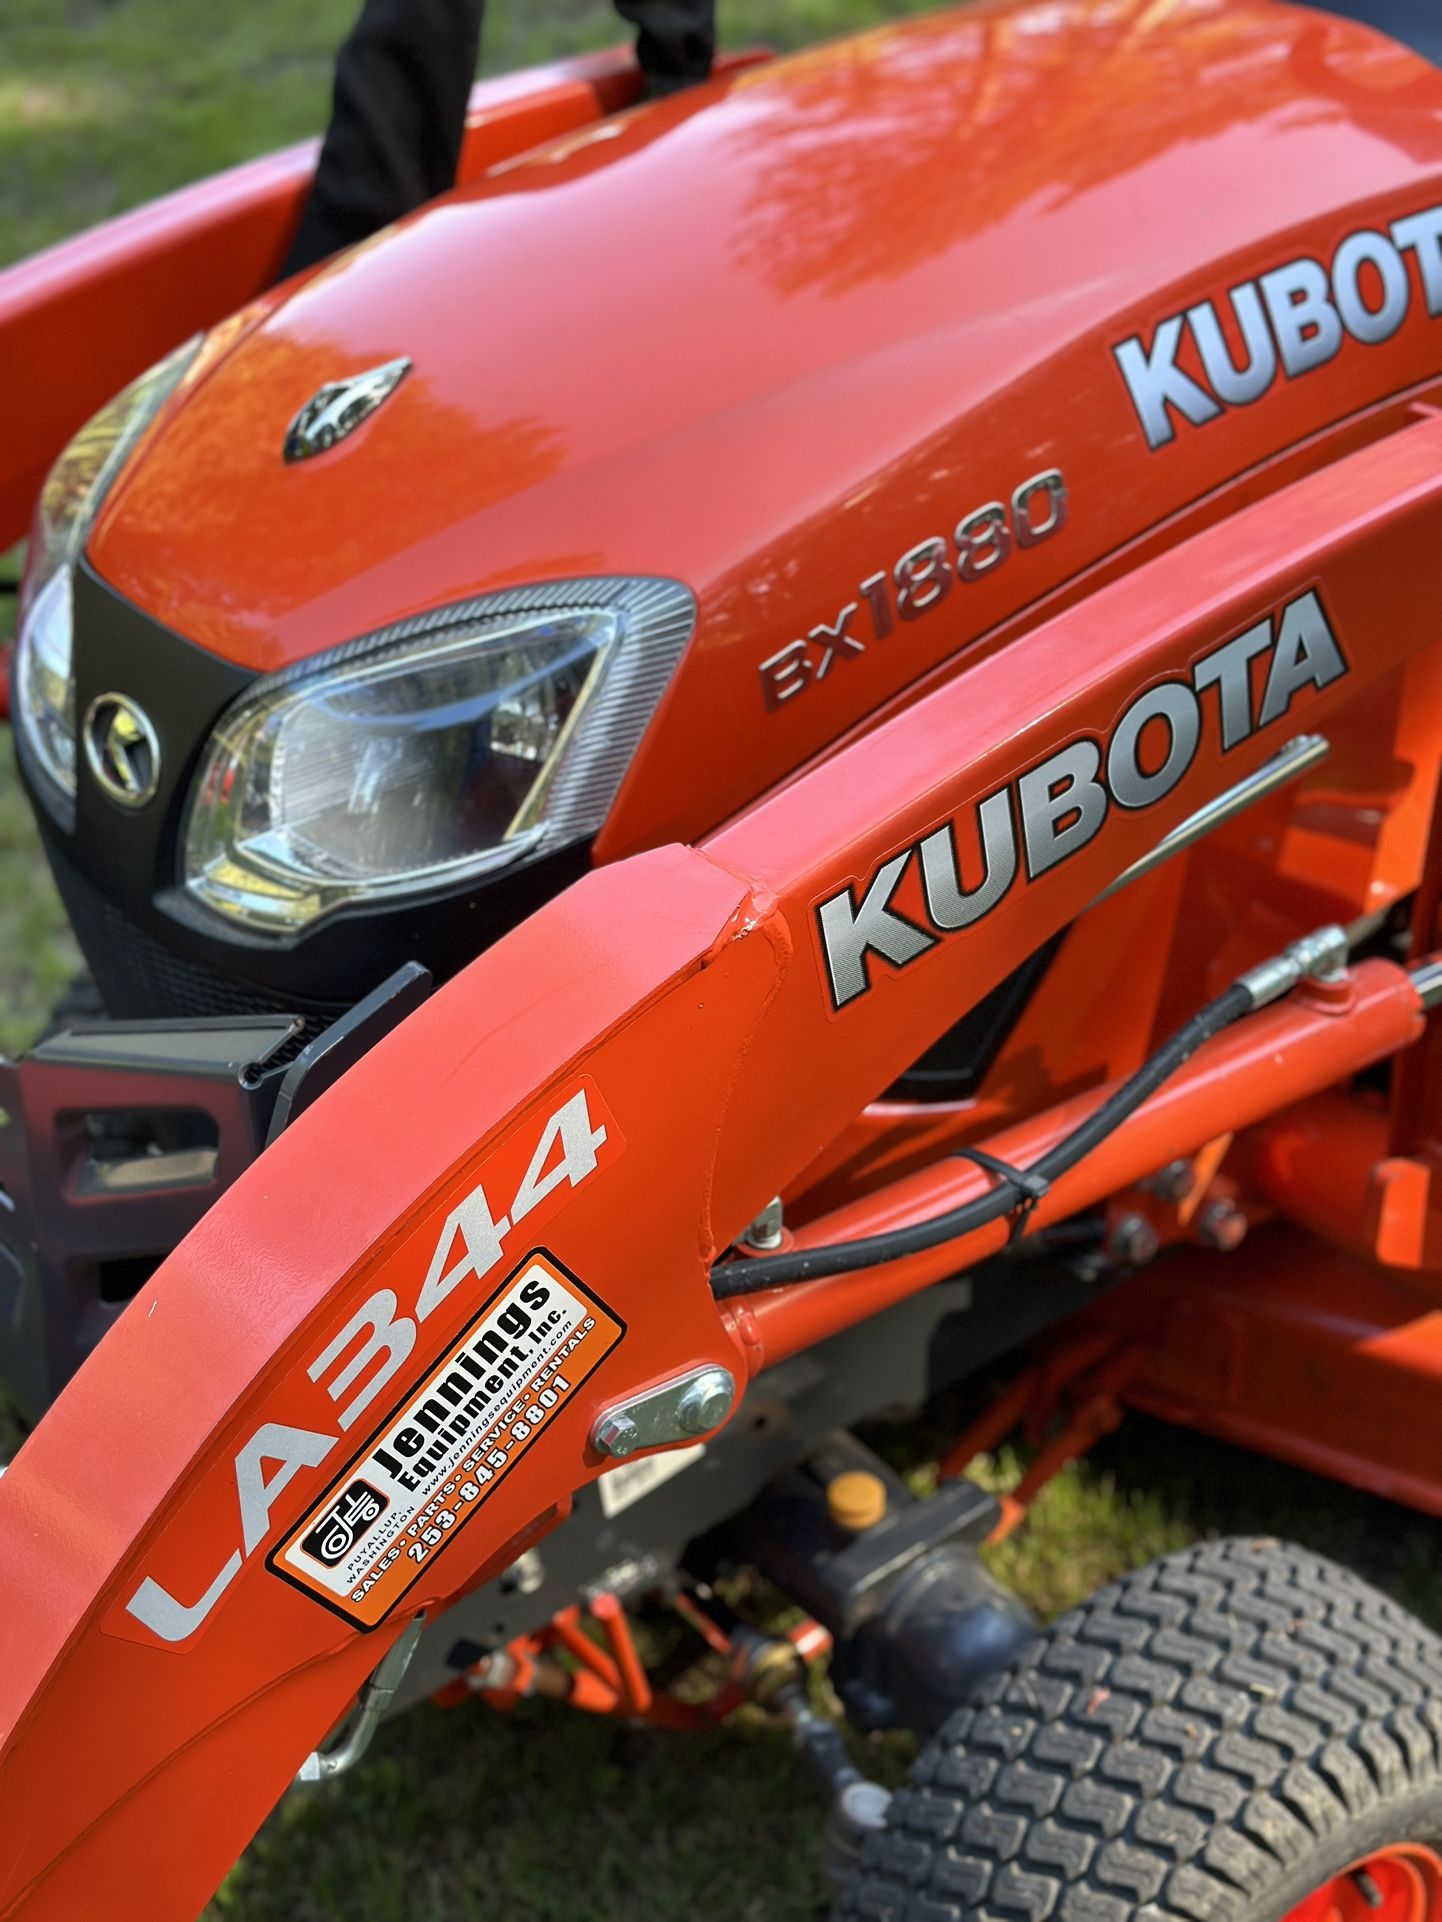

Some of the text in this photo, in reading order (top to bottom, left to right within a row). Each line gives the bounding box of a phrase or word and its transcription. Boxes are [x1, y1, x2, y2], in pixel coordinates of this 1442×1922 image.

[759, 468, 1068, 714] BX1880
[817, 588, 1349, 1012] KUBOTA
[125, 1088, 607, 1642] LA344
[371, 1280, 550, 1480] Jennings
[396, 1309, 567, 1493] Equipment, Inc.
[422, 1320, 572, 1496] www.jenningsequipment.com
[530, 1316, 597, 1392] RENTALS
[346, 1506, 415, 1584] WASHINGTON
[407, 1373, 572, 1564] 253-845-8801
